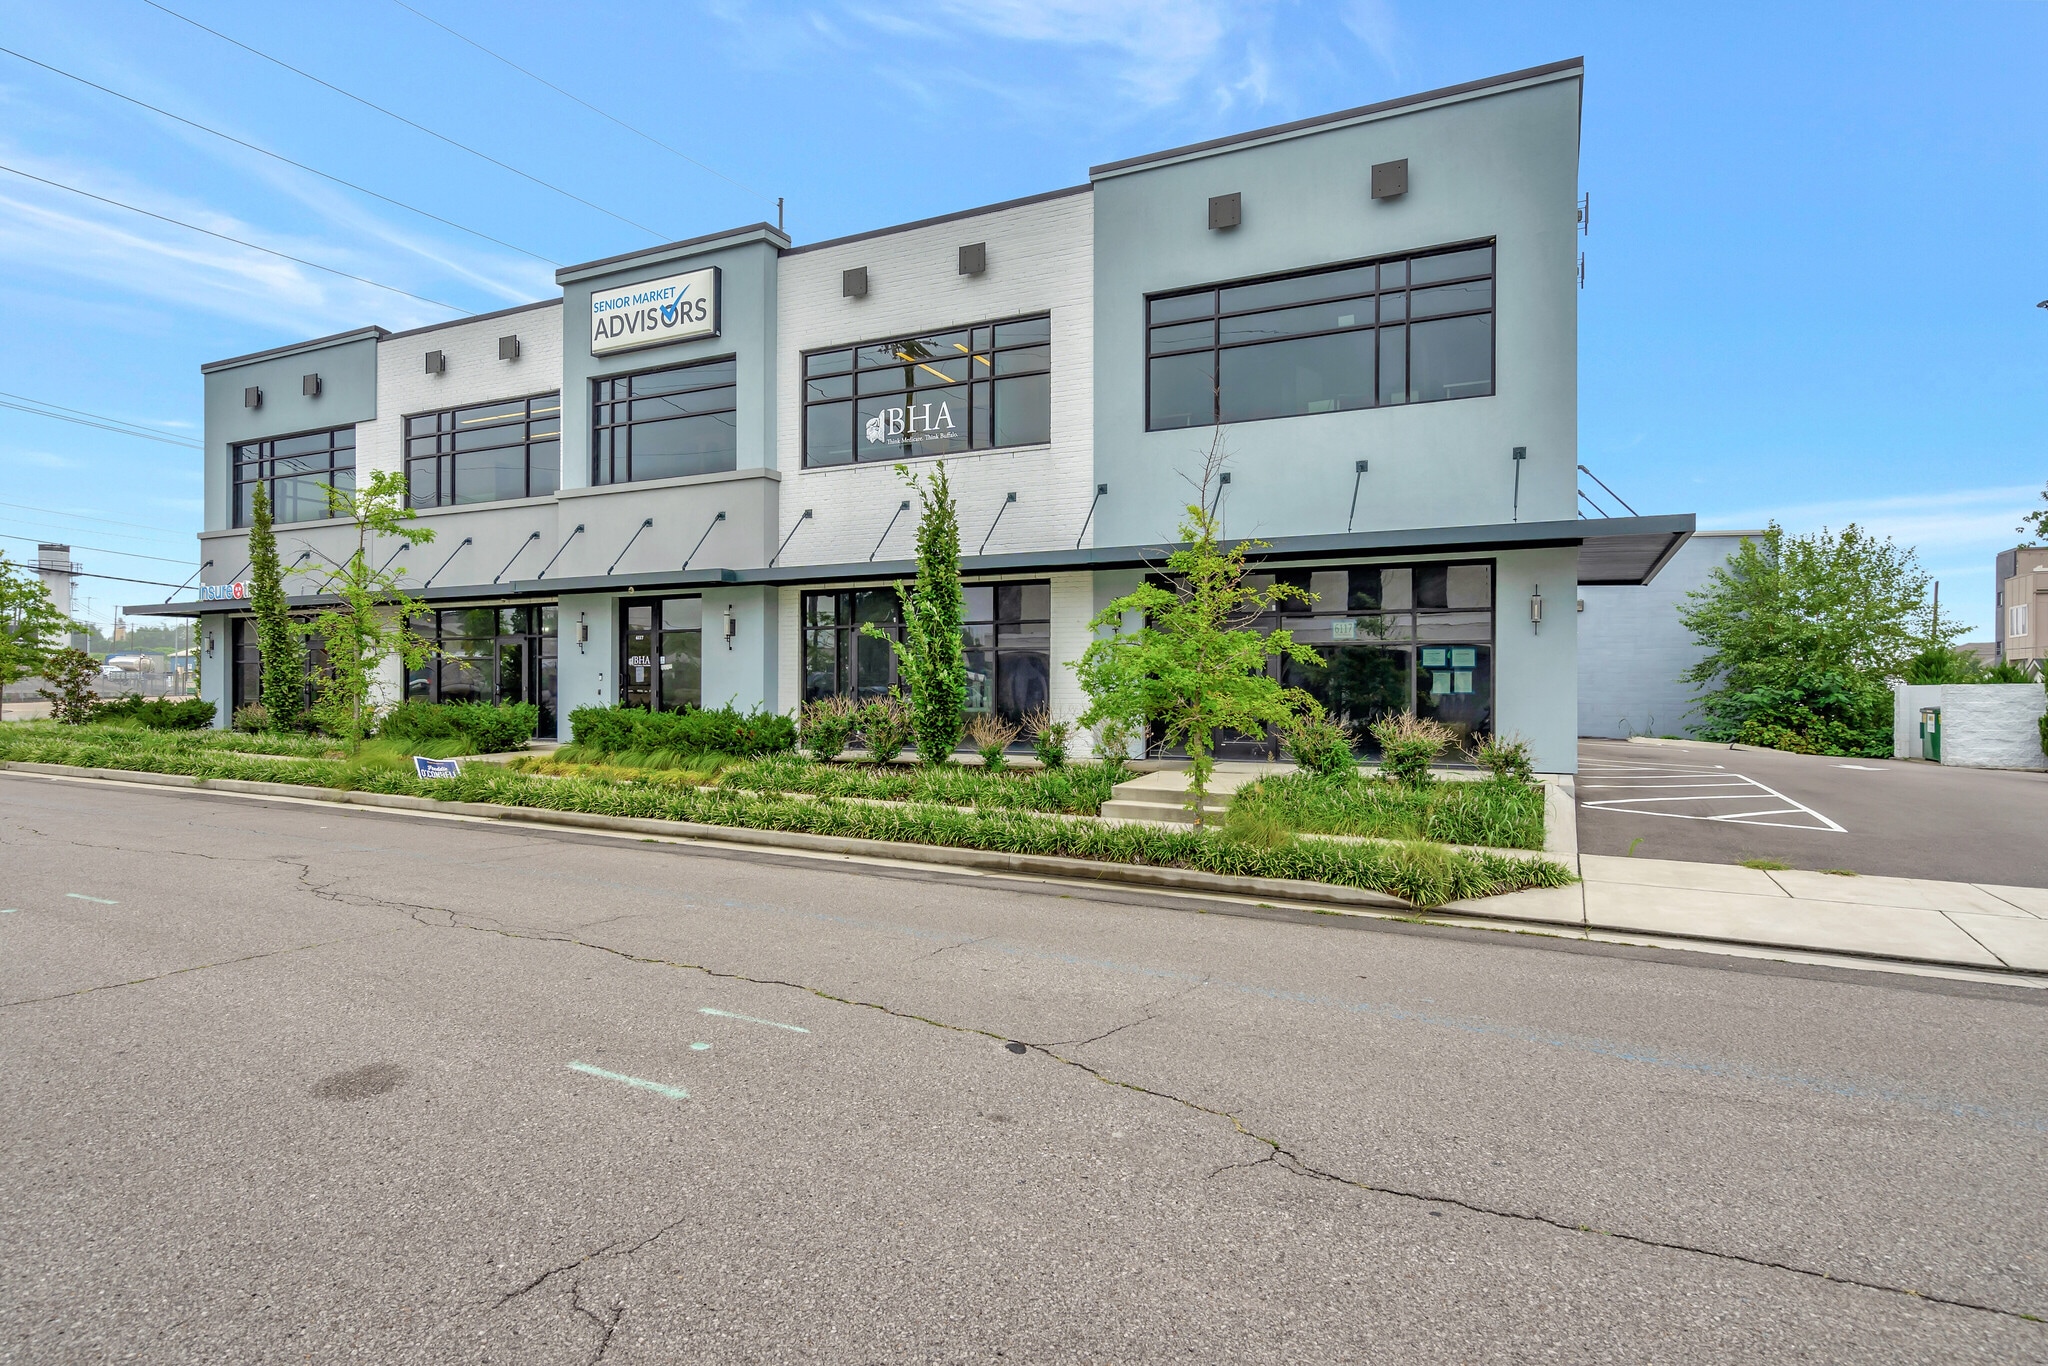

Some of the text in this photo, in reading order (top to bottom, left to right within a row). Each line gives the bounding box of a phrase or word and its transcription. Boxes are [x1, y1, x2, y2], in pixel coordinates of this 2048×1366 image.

[593, 286, 676, 313] SENIOR MARKET
[594, 297, 707, 341] ADVISORS
[886, 400, 956, 436] BHA
[925, 433, 939, 441] Think
[1334, 622, 1353, 634] 6117
[634, 655, 651, 665] BHA
